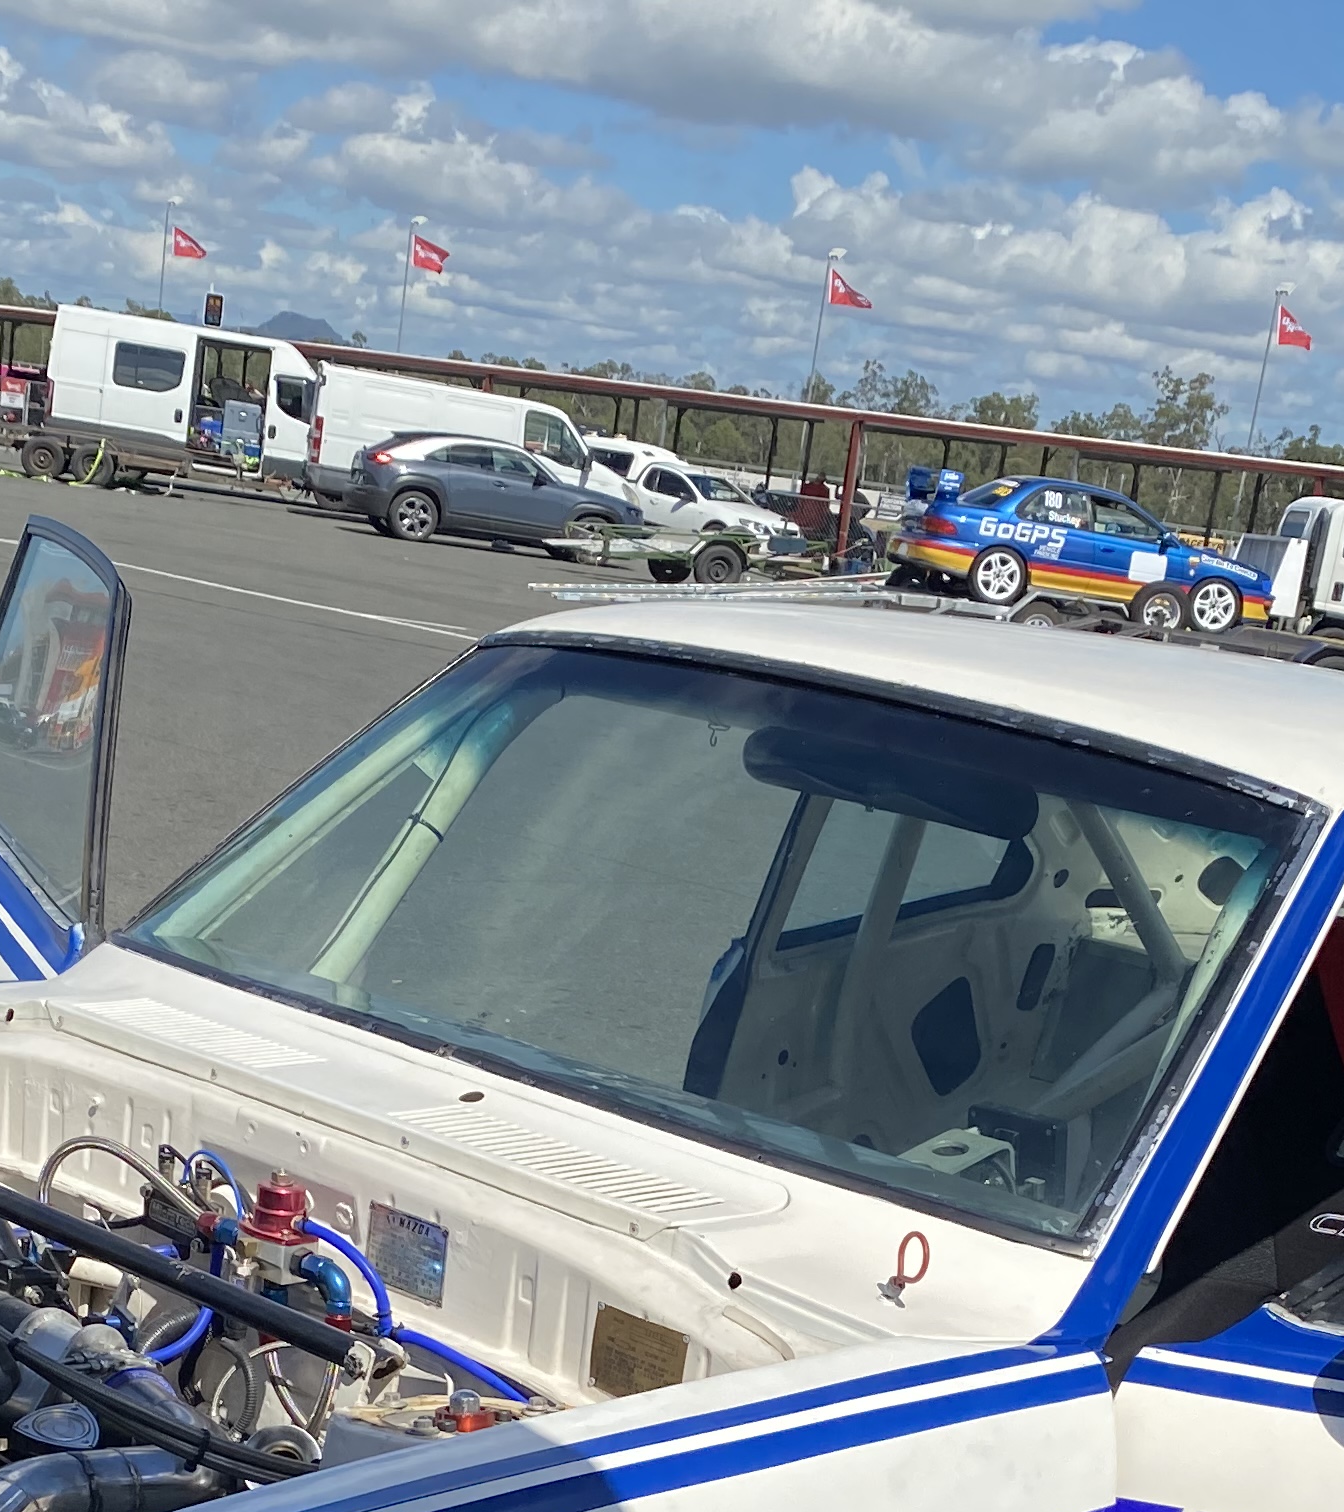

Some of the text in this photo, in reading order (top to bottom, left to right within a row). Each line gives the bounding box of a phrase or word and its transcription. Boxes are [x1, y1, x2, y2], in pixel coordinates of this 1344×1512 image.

[1044, 490, 1063, 509] 180
[979, 516, 1068, 548] GoGPS
[399, 1216, 430, 1238] MAZDA
